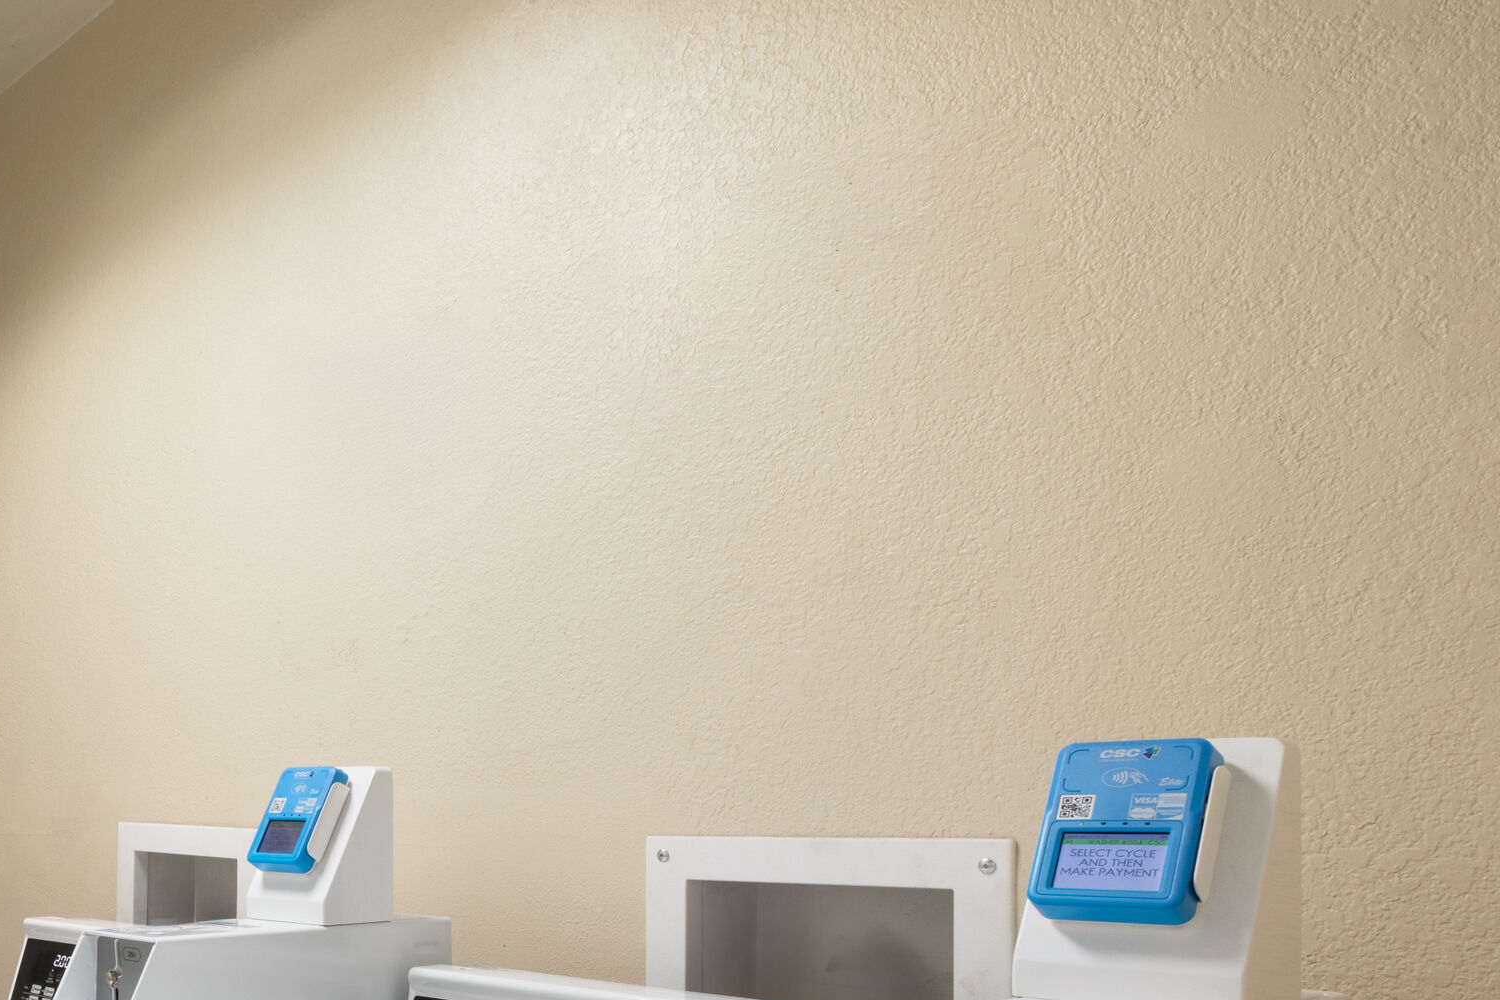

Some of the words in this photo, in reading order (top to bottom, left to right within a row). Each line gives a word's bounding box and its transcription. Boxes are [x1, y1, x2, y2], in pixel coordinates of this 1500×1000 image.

[1100, 748, 1141, 758] CSC
[1069, 848, 1112, 857] SELECT
[1115, 849, 1156, 858] CYCLE
[1079, 859, 1107, 867] AND
[1112, 859, 1143, 868] THEN
[1060, 867, 1095, 876] MAKE
[1099, 868, 1159, 878] PAYMENT
